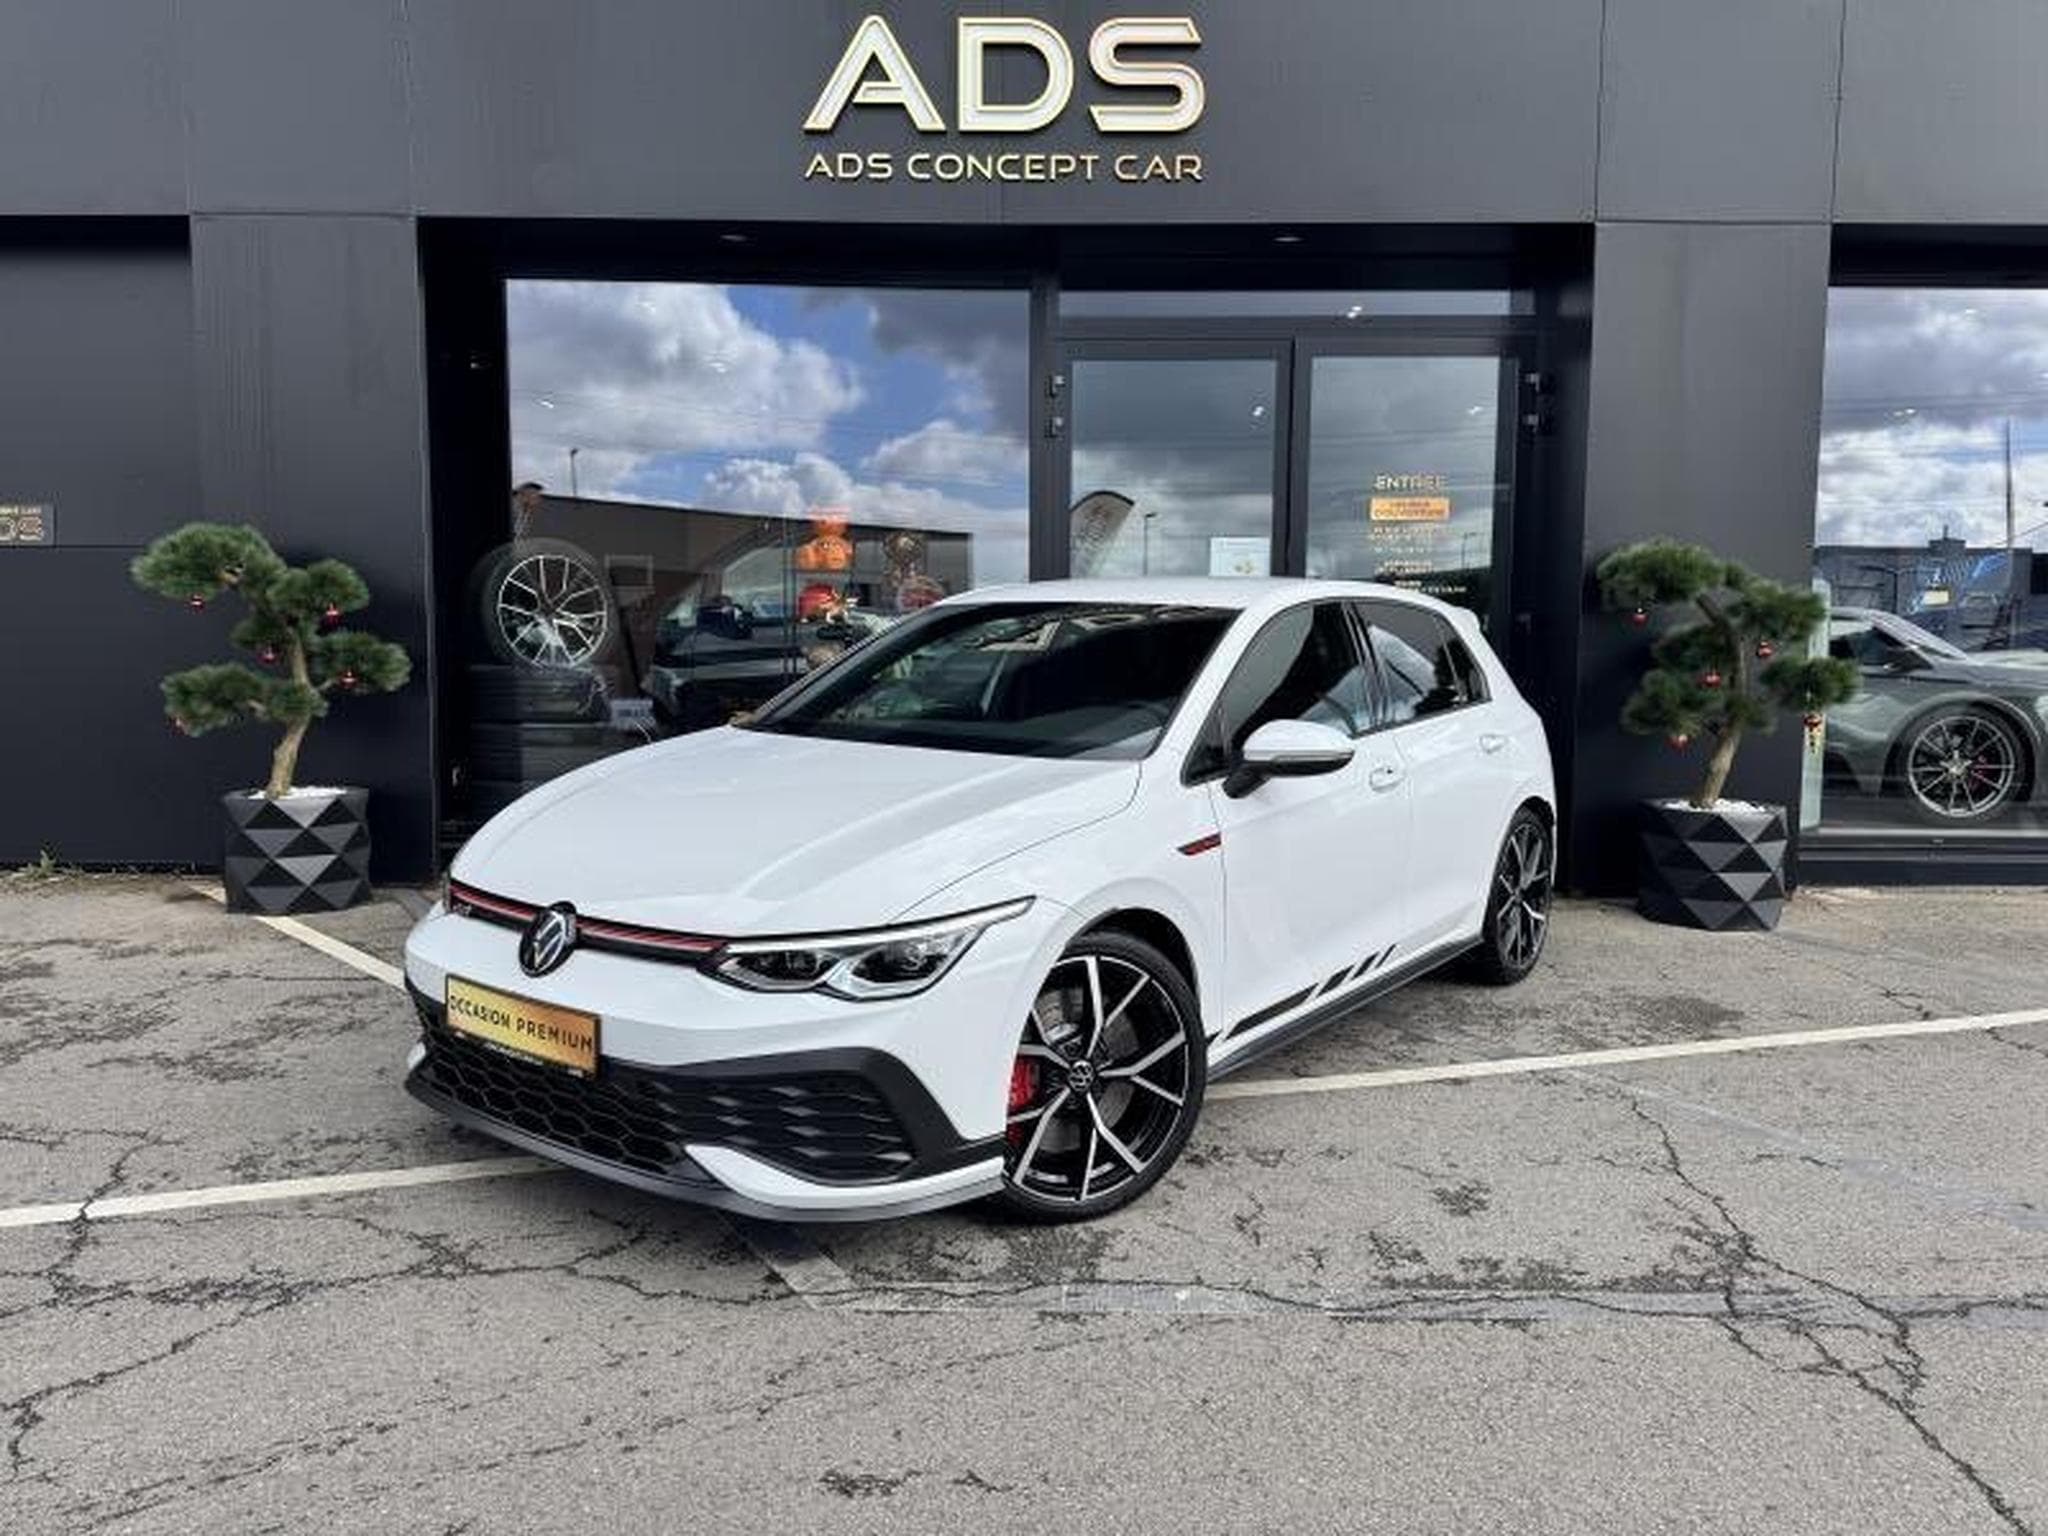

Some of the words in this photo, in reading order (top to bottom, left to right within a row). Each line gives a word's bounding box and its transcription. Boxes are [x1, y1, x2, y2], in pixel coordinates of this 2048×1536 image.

[803, 14, 1205, 132] ADS
[804, 153, 894, 180] ADS
[907, 153, 1099, 181] CONCEPT
[1114, 154, 1202, 181] CAR
[449, 995, 510, 1028] OCCASION
[516, 1018, 592, 1052] PREMIUM
